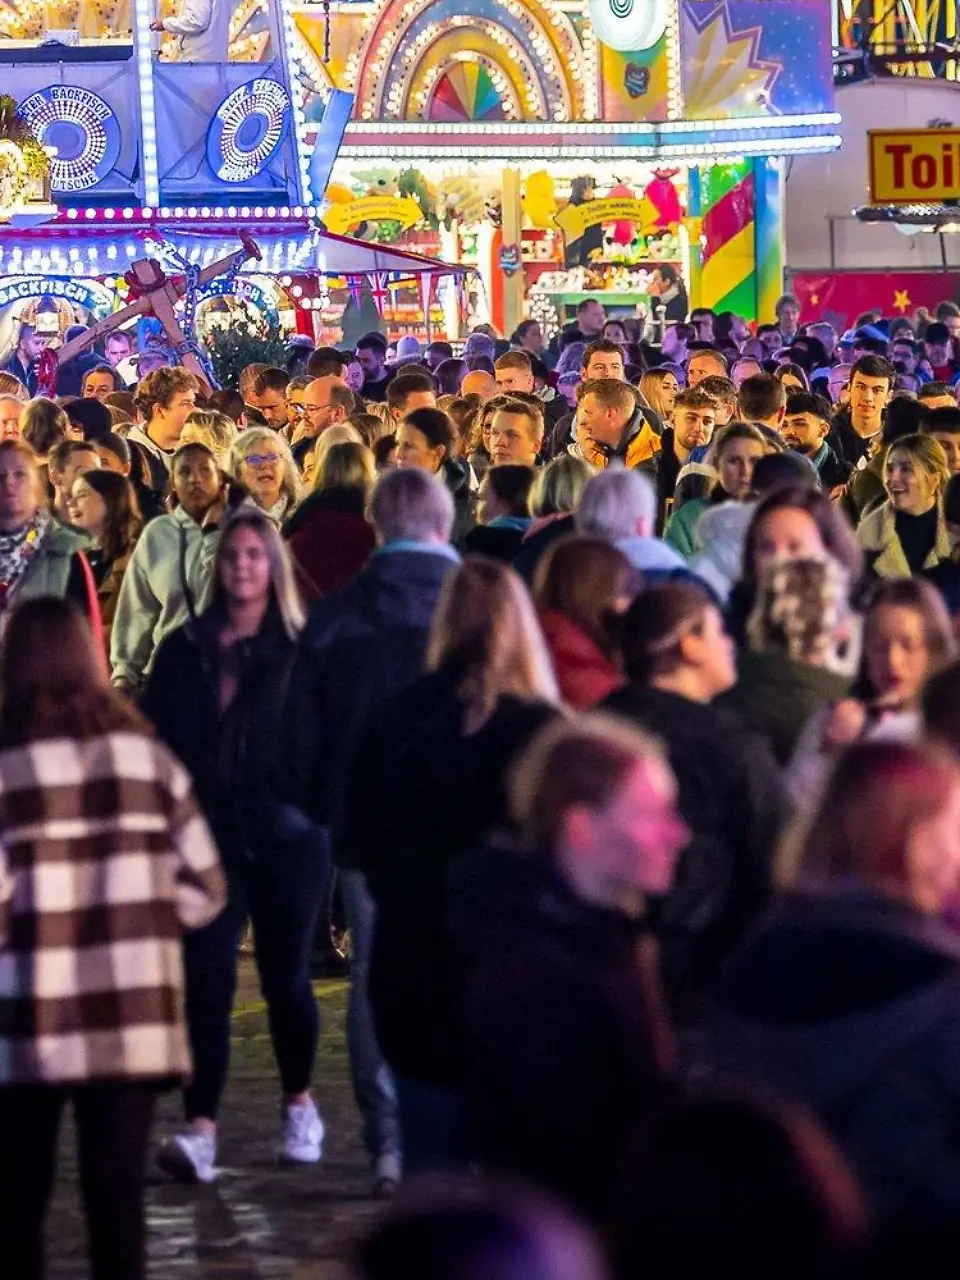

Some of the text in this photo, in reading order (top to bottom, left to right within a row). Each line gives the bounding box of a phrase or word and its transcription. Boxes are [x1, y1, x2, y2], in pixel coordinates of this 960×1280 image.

[51, 88, 110, 120] BACKFISCH
[51, 173, 98, 191] UTSCHE
[884, 143, 960, 190] Toi
